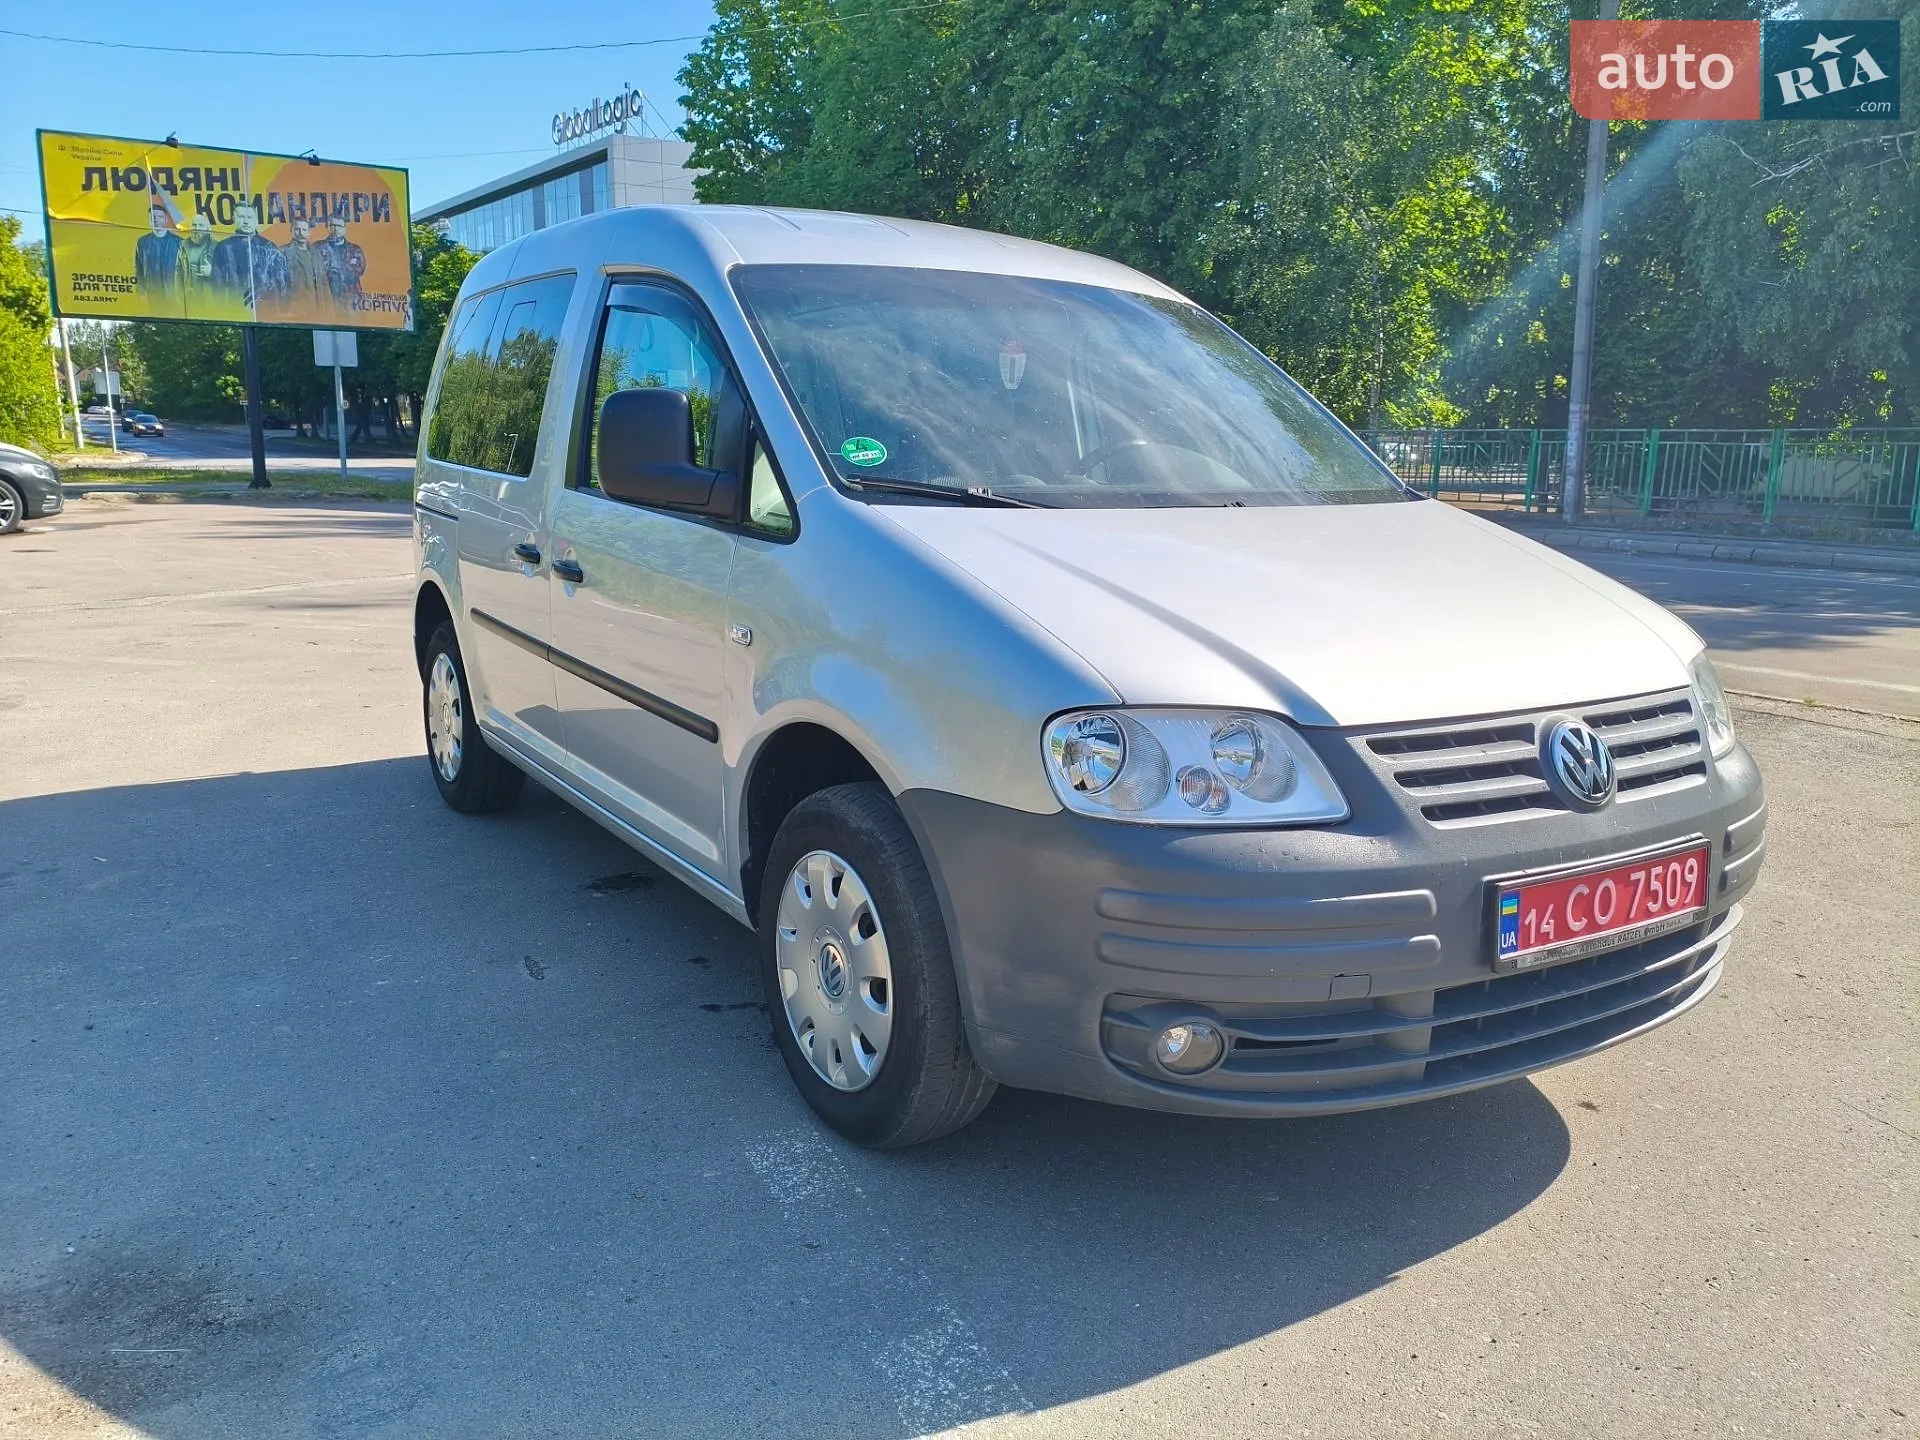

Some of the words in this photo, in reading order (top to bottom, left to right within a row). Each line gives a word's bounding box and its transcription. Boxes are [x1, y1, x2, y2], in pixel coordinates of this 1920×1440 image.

[552, 82, 643, 145] GlobalLogic
[81, 166, 241, 196] ЛЮДЯНІ
[195, 192, 391, 229] КОМАНДИРИ
[71, 272, 138, 285] ЗРОБЛЕНО
[72, 281, 100, 292] ДЛЯ
[102, 283, 133, 294] ТЕБЕ
[1524, 903, 1555, 945] 14
[1565, 878, 1617, 932] CO
[1627, 857, 1699, 919] 7509
[1501, 931, 1517, 949] UA
